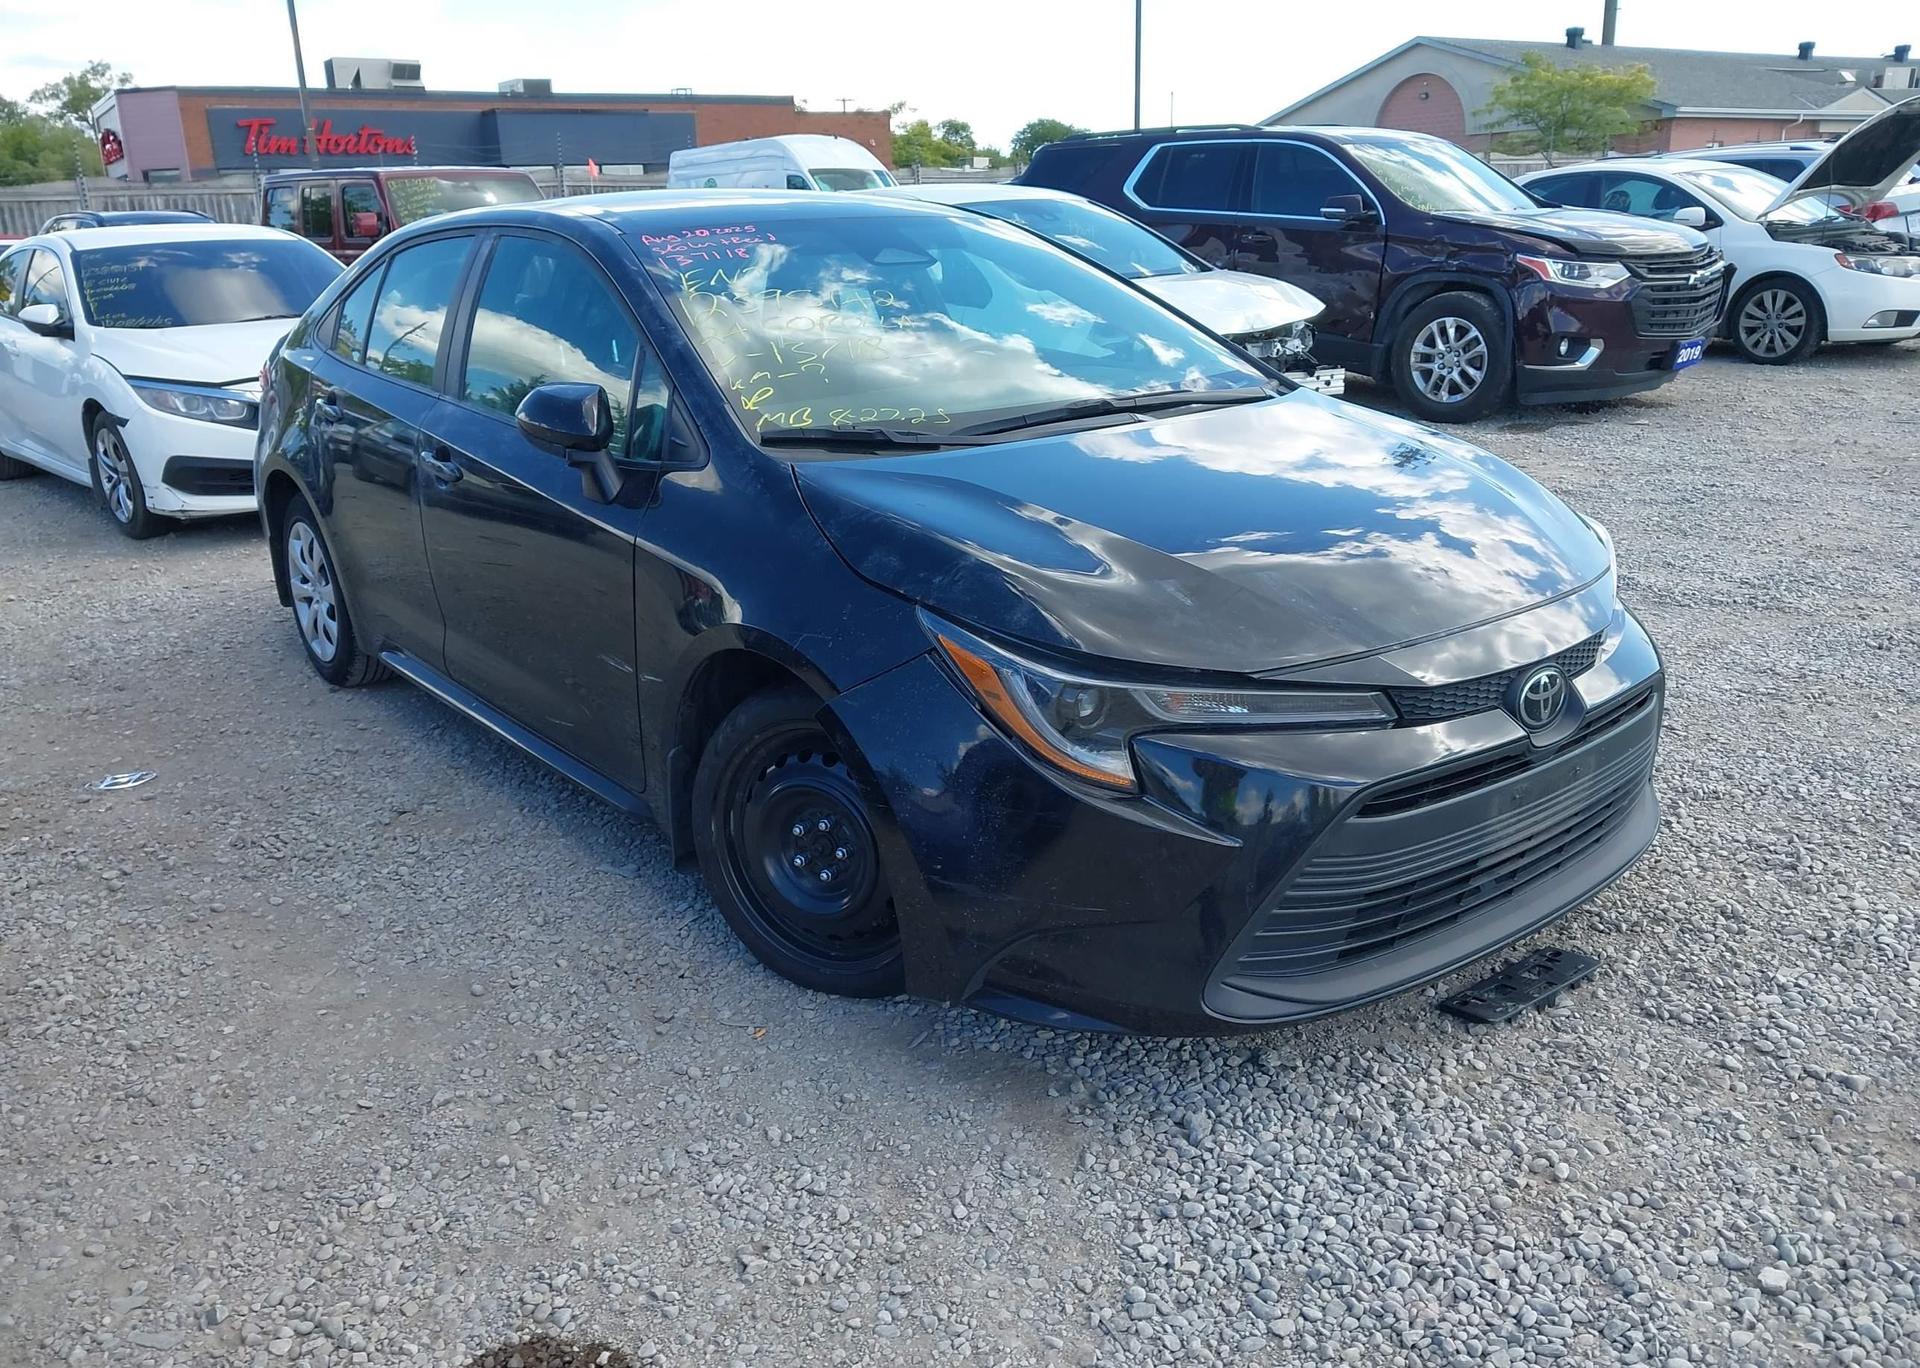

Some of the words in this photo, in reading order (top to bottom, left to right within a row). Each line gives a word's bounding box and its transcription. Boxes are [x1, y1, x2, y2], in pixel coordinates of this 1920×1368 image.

[237, 118, 299, 155] Tim
[303, 119, 416, 155] Hortons
[658, 248, 750, 270] 137118
[1676, 345, 1702, 363] 2019
[756, 407, 813, 432] MB
